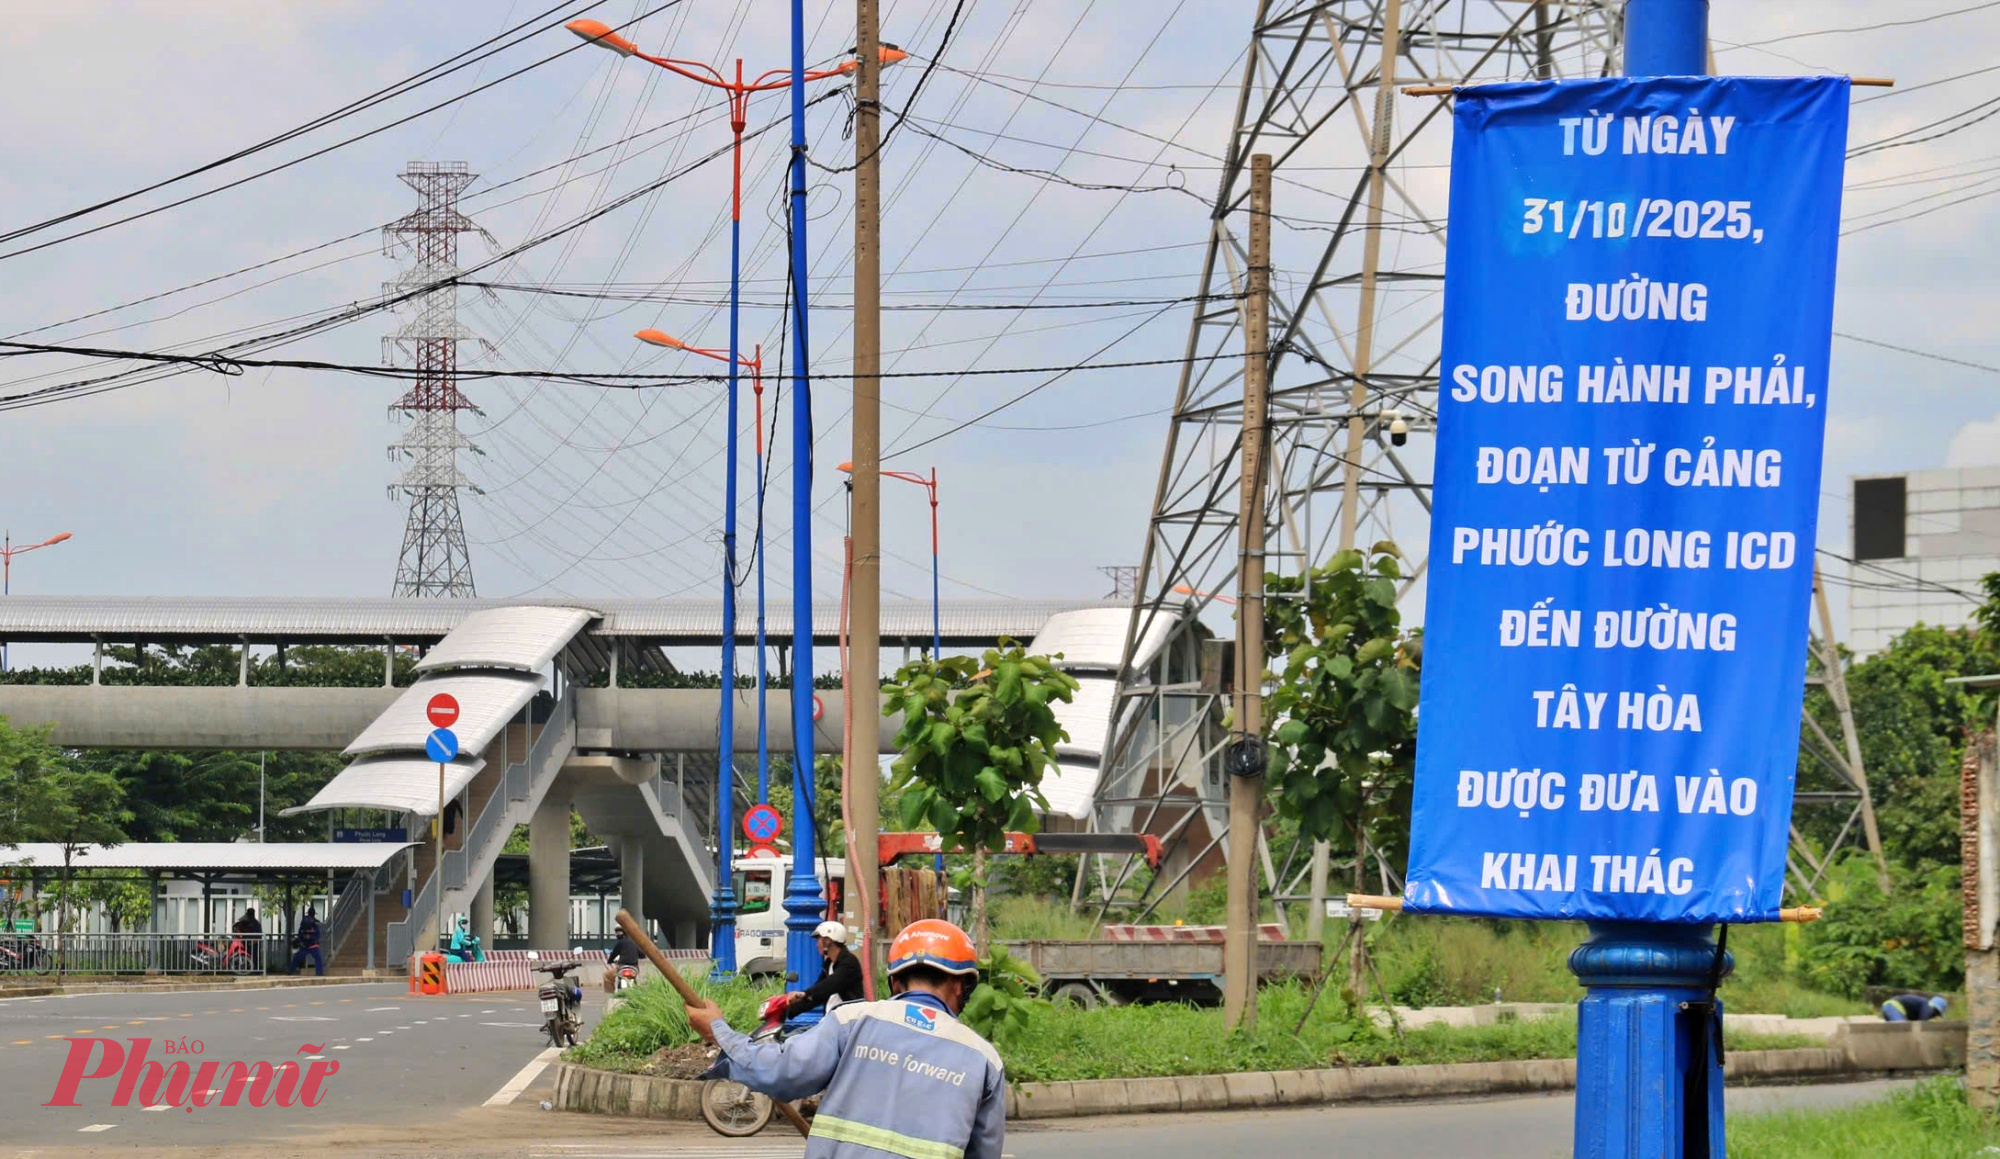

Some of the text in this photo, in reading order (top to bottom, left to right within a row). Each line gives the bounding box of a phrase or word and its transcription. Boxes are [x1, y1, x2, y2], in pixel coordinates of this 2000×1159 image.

[1560, 107, 1735, 155] TỪ NGÀY
[1565, 273, 1707, 321] ĐƯỜNG
[1452, 353, 1816, 408] SONG HÀNH PHẢI,
[1477, 436, 1781, 492] ĐOẠN TỪ CẢNG
[1452, 520, 1796, 569] PHƯỚC LONG ICD
[1500, 597, 1737, 651] ĐẾN ĐƯỜNG
[1533, 684, 1702, 732] TÂY HÒA
[1457, 768, 1757, 818] ĐƯỢC ĐƯA VÀO
[1481, 848, 1694, 895] KHAI THÁC
[854, 1045, 966, 1086] move forward
